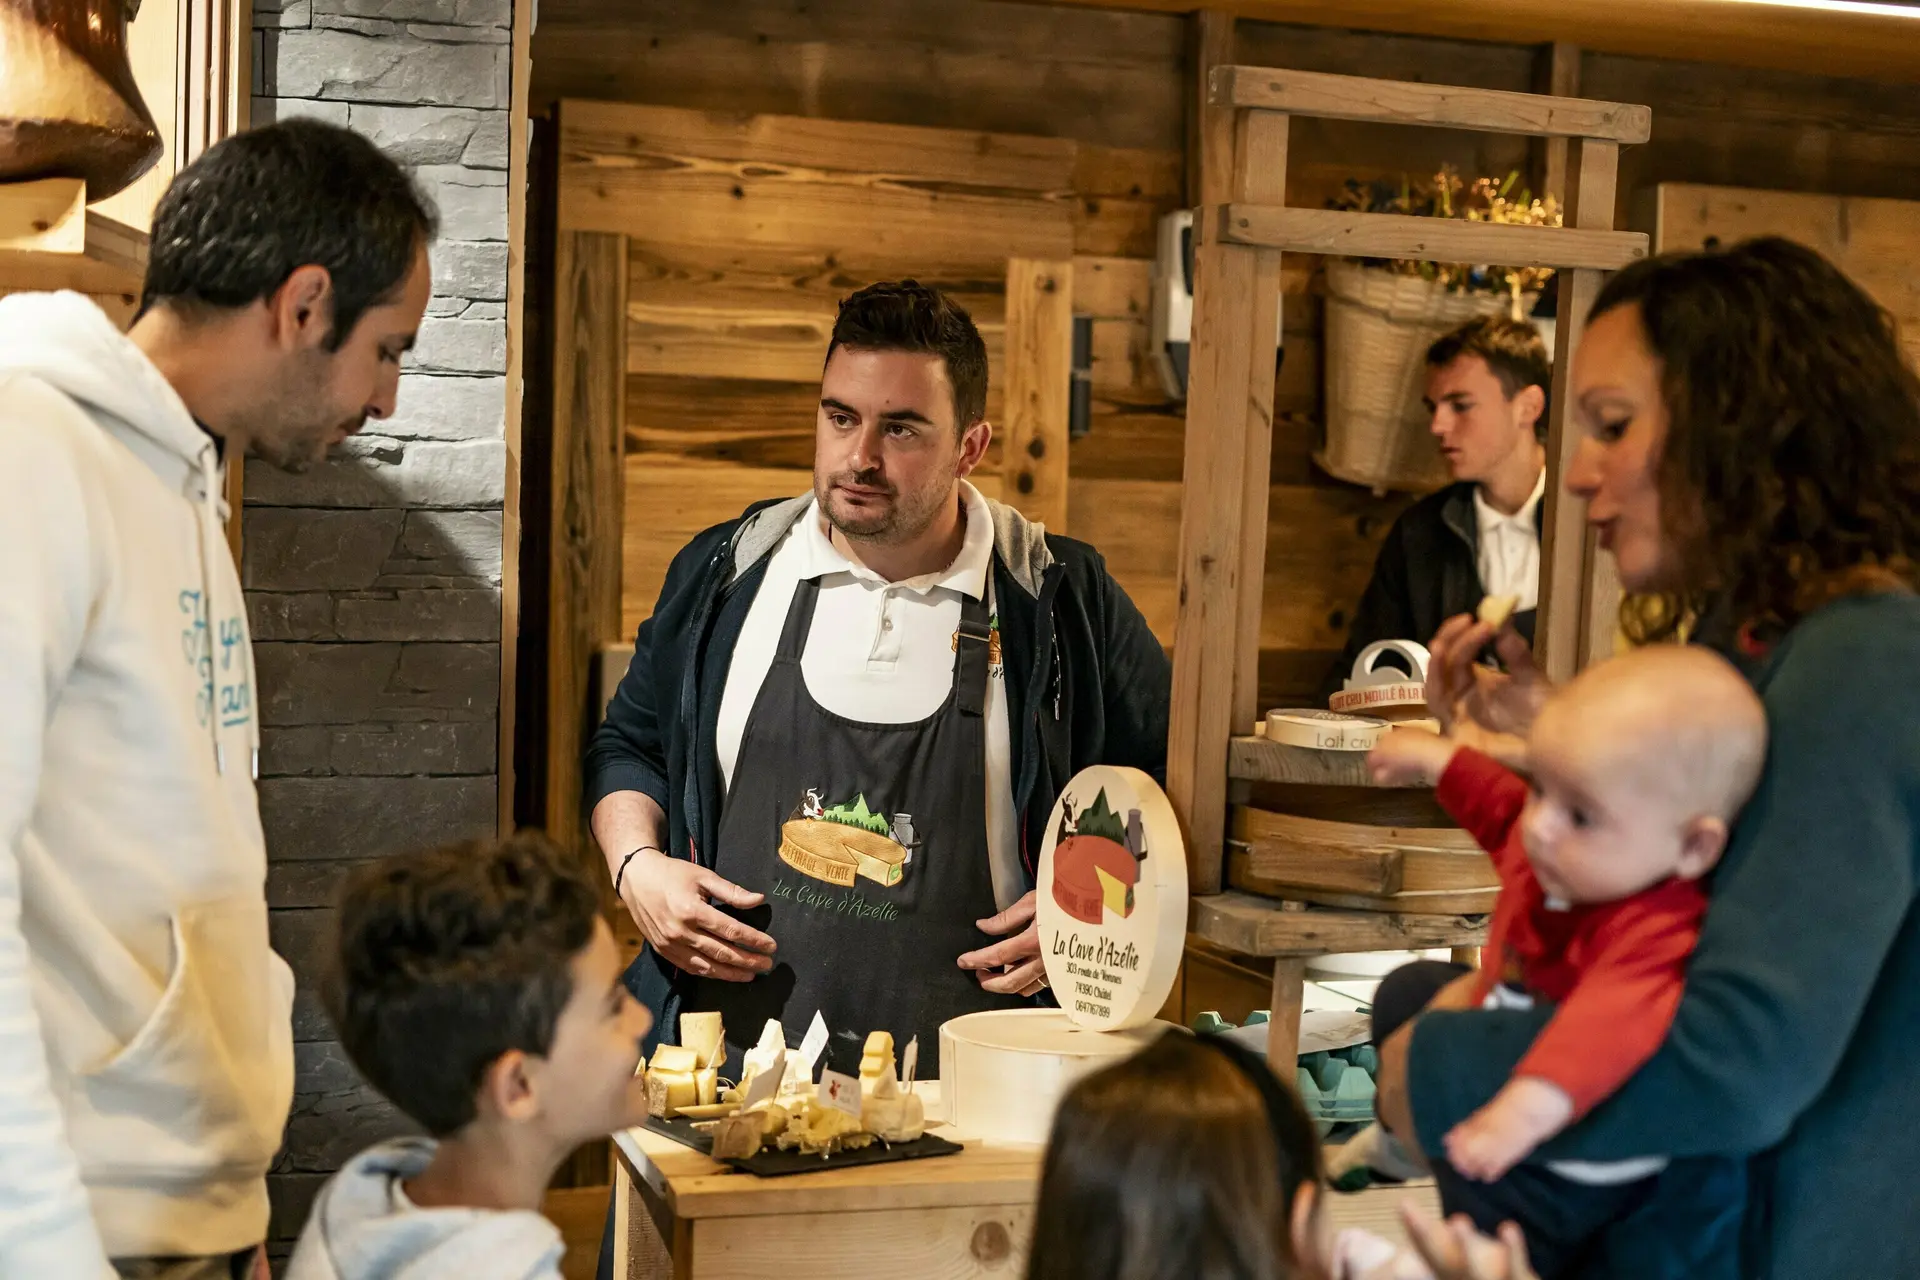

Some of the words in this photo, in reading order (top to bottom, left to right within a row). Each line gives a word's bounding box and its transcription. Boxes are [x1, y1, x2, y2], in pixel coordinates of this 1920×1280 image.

[1346, 692, 1362, 706] CRU
[1364, 686, 1395, 704] MOULÉ
[1398, 684, 1406, 700] À
[1408, 687, 1419, 700] LA
[1316, 731, 1344, 748] Lait
[1350, 737, 1372, 749] cru
[825, 863, 850, 881] VENTE
[772, 879, 792, 898] La
[797, 885, 834, 908] Cave
[837, 892, 899, 921] d'Azélie
[1053, 930, 1066, 955] La
[1069, 933, 1095, 961] Cave
[1096, 936, 1139, 971] d'Azélie
[1066, 962, 1077, 974] 303
